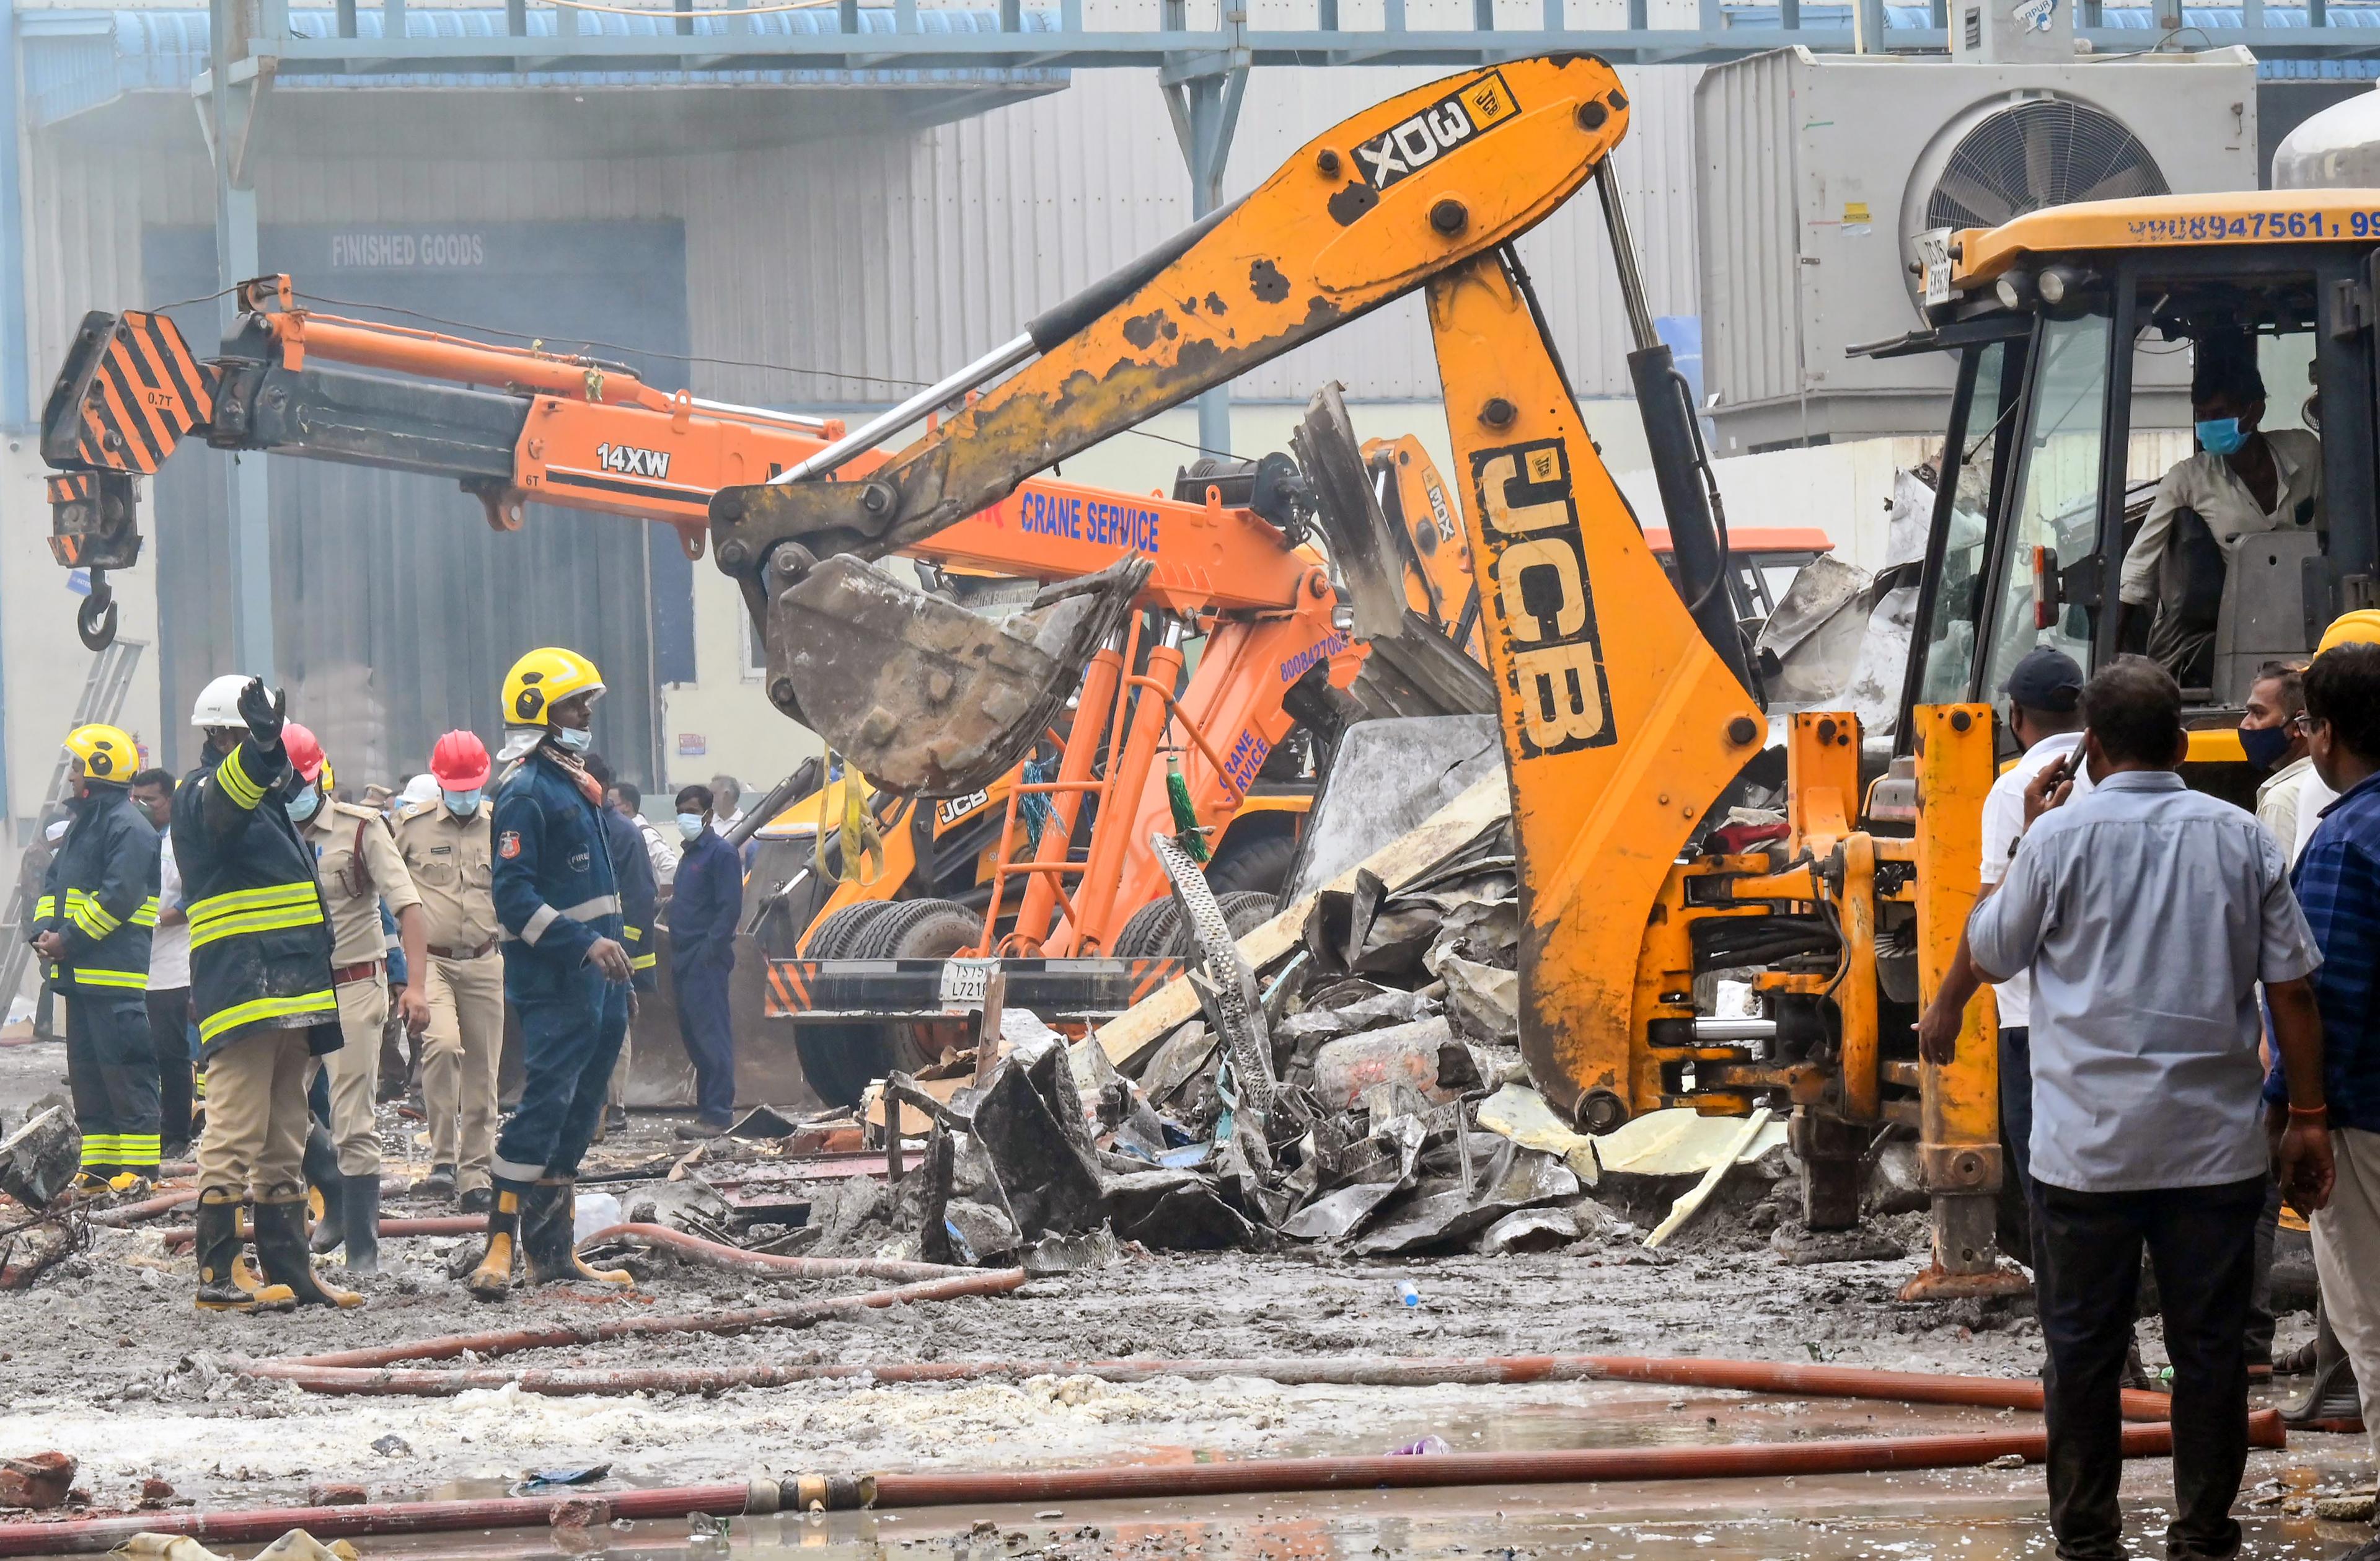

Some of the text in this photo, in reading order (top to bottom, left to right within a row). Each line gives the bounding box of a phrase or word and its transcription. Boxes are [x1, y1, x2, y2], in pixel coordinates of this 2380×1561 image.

[1476, 89, 1498, 116] JCB
[1358, 101, 1471, 190] 3DX
[333, 233, 484, 267] FINISHED GOODS
[148, 392, 173, 407] 0.7T
[596, 436, 671, 479] 14XW
[1535, 456, 1550, 477] JCB
[526, 475, 539, 487] 6T
[1021, 492, 1082, 540] CRANE
[1086, 502, 1159, 553] SERVICE
[1482, 453, 1603, 748] JCB
[941, 788, 987, 823] JCB
